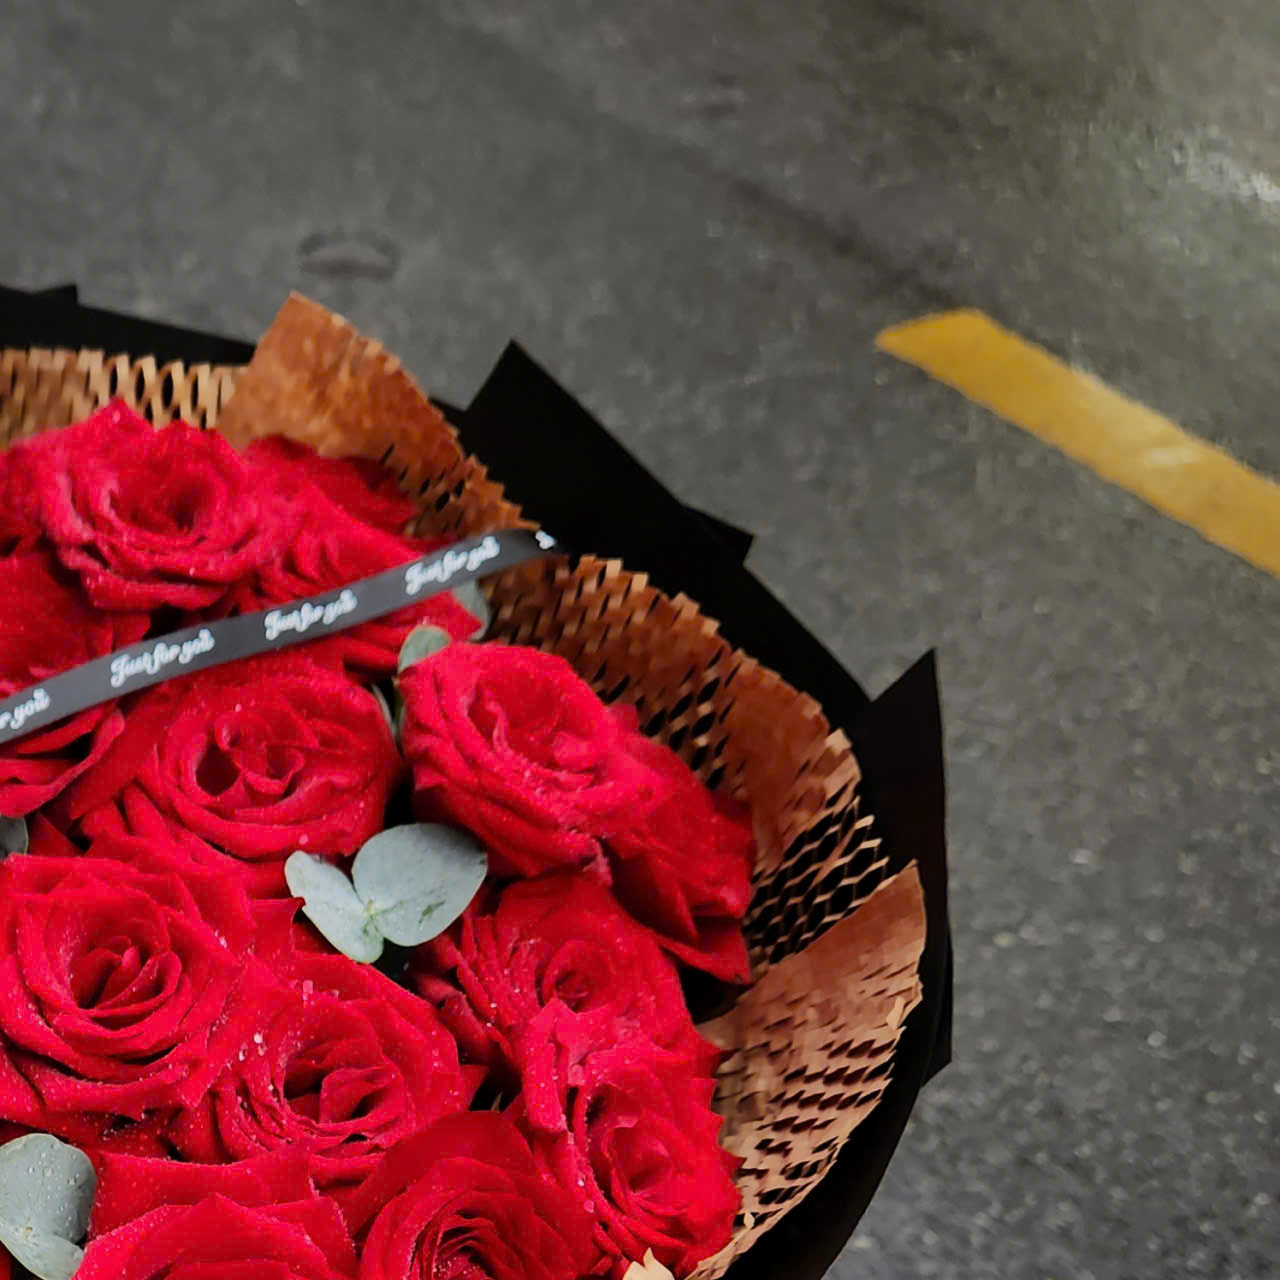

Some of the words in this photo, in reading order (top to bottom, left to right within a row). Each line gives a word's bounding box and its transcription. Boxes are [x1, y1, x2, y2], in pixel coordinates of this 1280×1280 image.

[323, 589, 358, 624] you
[111, 652, 152, 688] Just
[145, 643, 180, 675] for
[179, 629, 215, 664] you
[10, 688, 50, 729] you
